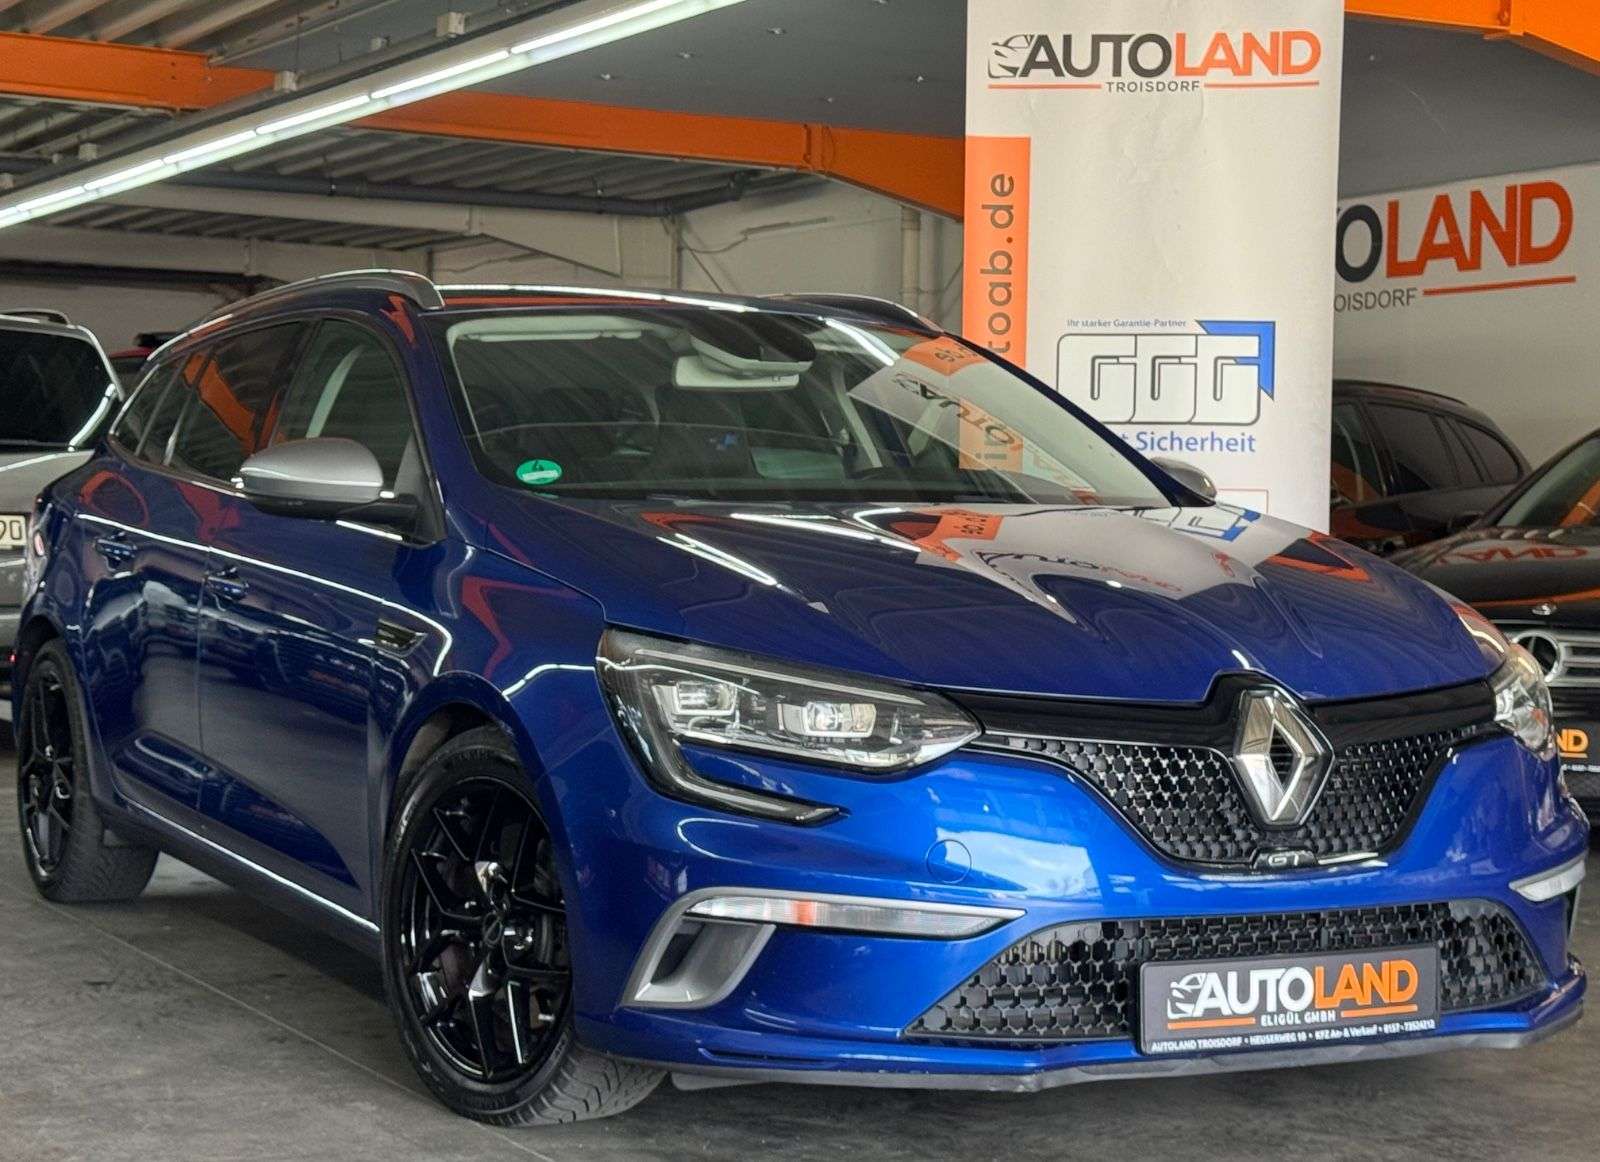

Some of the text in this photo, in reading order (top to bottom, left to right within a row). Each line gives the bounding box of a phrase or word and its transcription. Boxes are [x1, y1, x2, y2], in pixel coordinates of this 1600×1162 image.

[1019, 31, 1321, 78] AUTOLAND
[1106, 80, 1200, 93] TROISDORF
[1335, 180, 1574, 283] OLAND
[981, 173, 1015, 355] toab.de
[1334, 287, 1417, 312] OISDORF
[1136, 431, 1256, 453] Sicherheit
[1193, 959, 1419, 1017] AUTOLAND
[1151, 1039, 1197, 1052] AUTOLAND
[1197, 1036, 1242, 1050] TROISDORF
